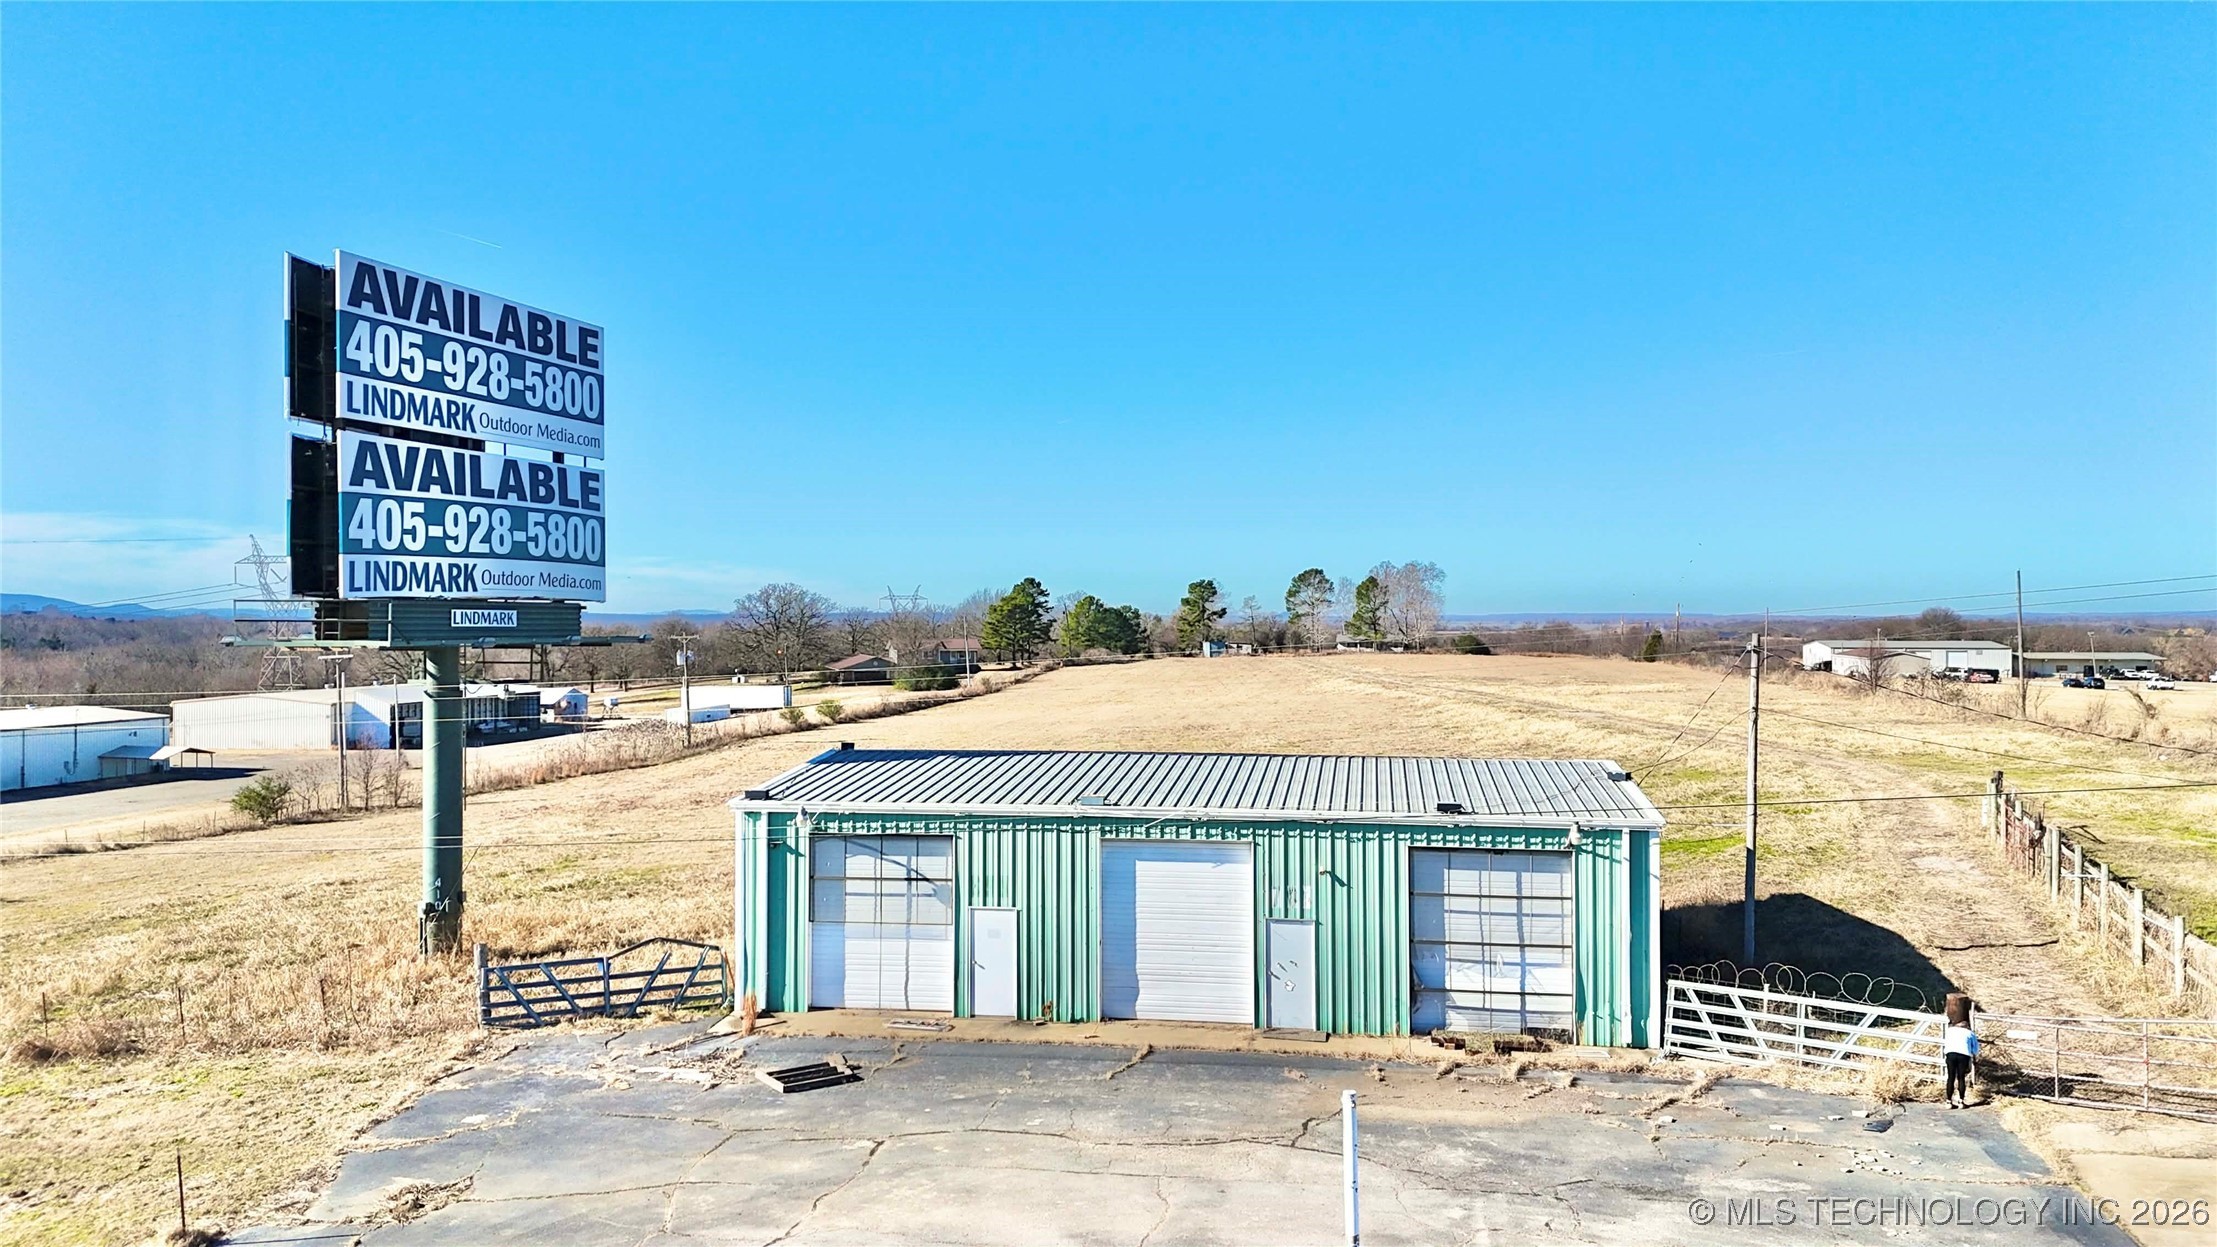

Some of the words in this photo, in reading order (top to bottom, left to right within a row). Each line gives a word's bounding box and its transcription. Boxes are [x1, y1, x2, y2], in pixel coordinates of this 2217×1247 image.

[347, 261, 599, 370] AVAILABLE
[346, 319, 601, 419] 405-928-5800
[346, 380, 477, 433] LINDMARK
[479, 412, 533, 437] Outdoor
[536, 424, 601, 449] Media.com
[349, 439, 601, 512] AVAILABLE
[348, 498, 601, 562] 405-928-5800
[349, 560, 478, 592] LINDMARK
[481, 569, 536, 587] Outdoor
[538, 572, 602, 591] Media.com
[453, 611, 515, 625] LINDMARK
